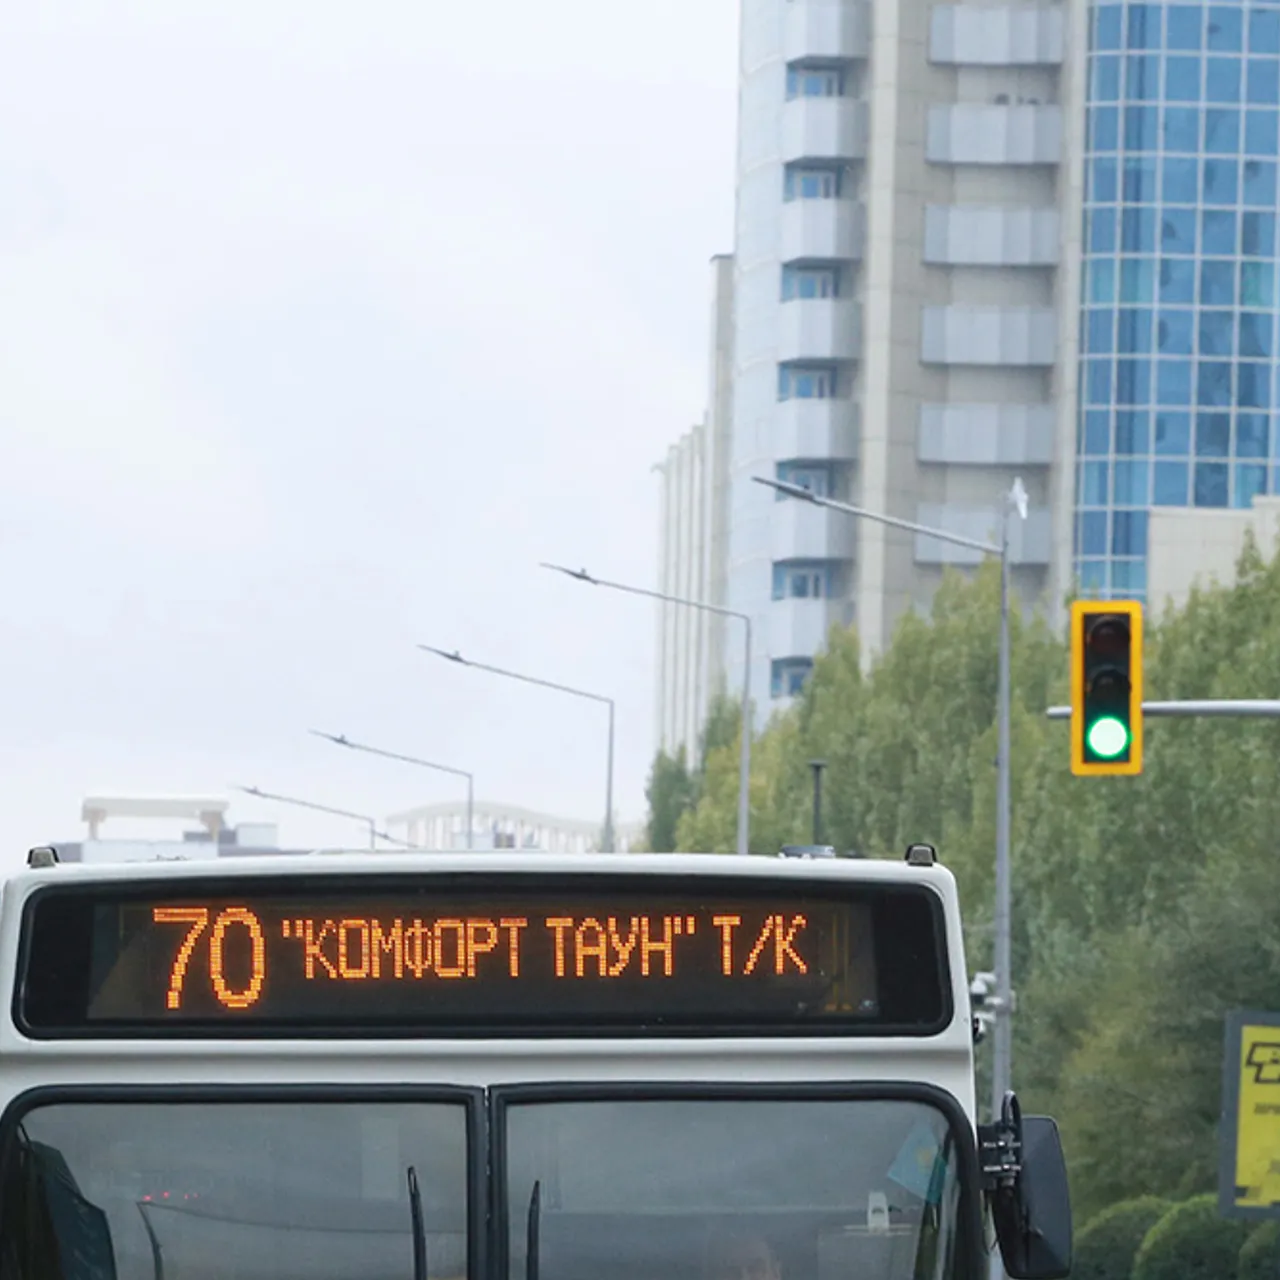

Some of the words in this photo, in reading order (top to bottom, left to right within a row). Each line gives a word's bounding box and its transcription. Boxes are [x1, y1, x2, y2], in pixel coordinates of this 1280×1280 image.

[153, 907, 265, 1009] 70
[282, 918, 528, 979] "КОМФОРТ
[545, 916, 695, 977] ТАУН"
[713, 915, 807, 976] Т/К
